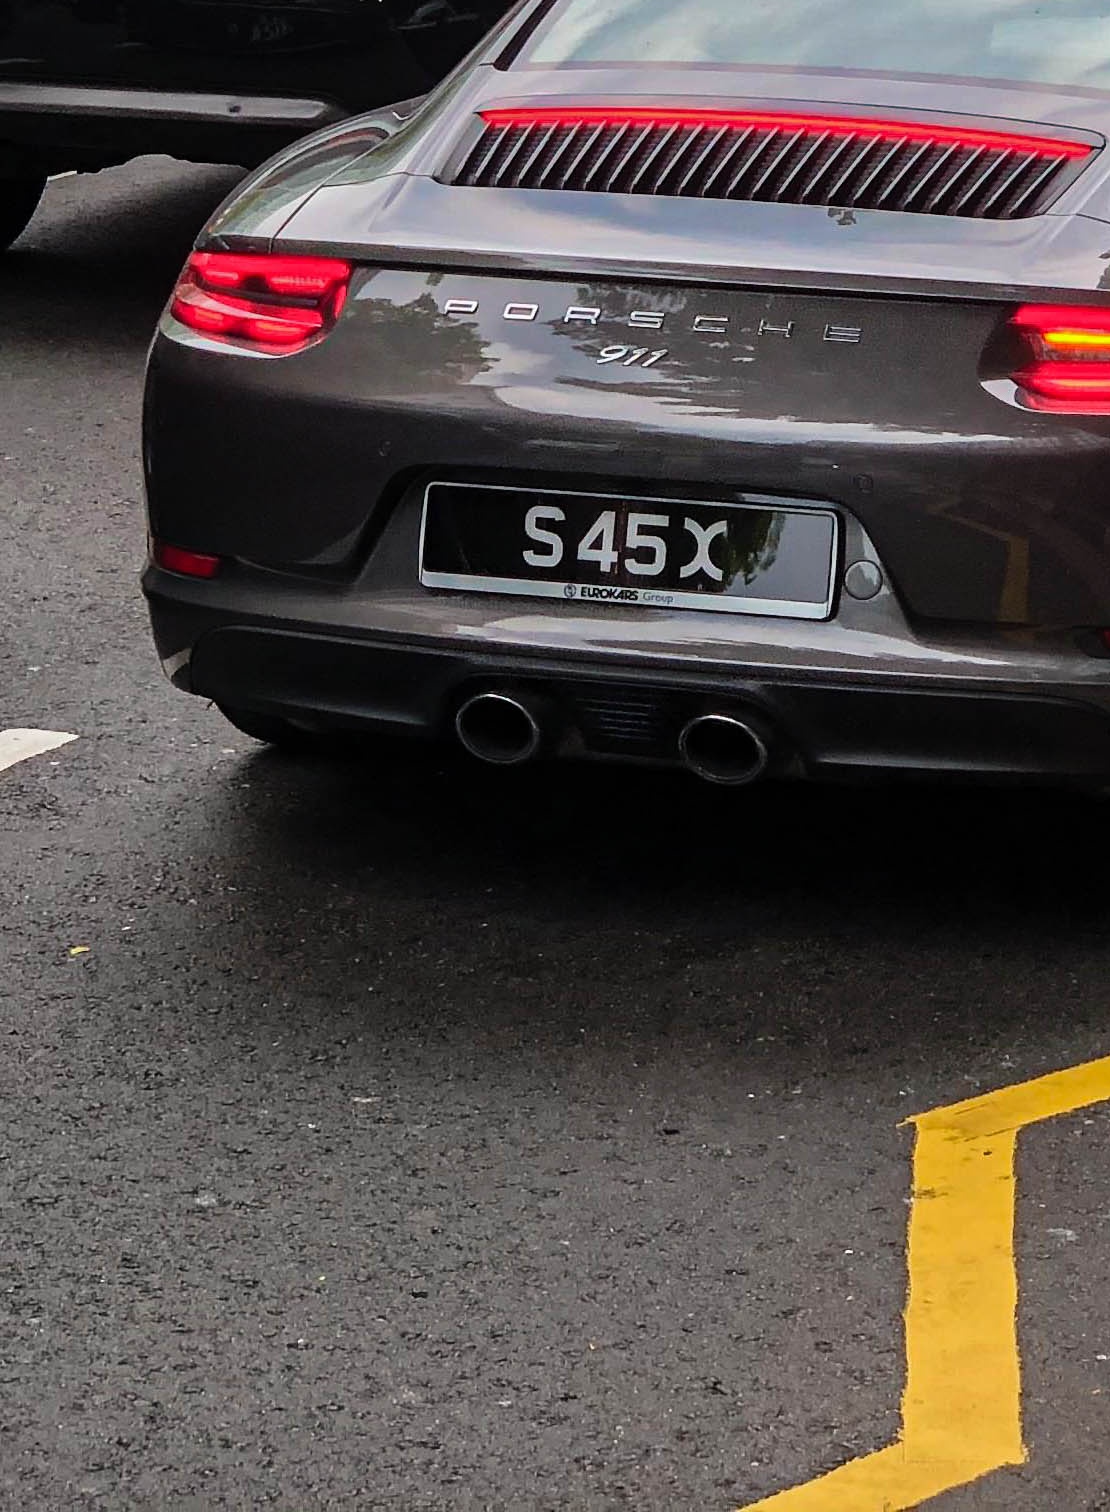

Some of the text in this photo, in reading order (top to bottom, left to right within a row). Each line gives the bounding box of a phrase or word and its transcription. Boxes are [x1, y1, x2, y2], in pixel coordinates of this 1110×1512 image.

[443, 299, 862, 343] PORSCHE
[596, 344, 668, 367] 911
[522, 505, 728, 582] S 45 X
[580, 586, 674, 605] EUROKARS Group
